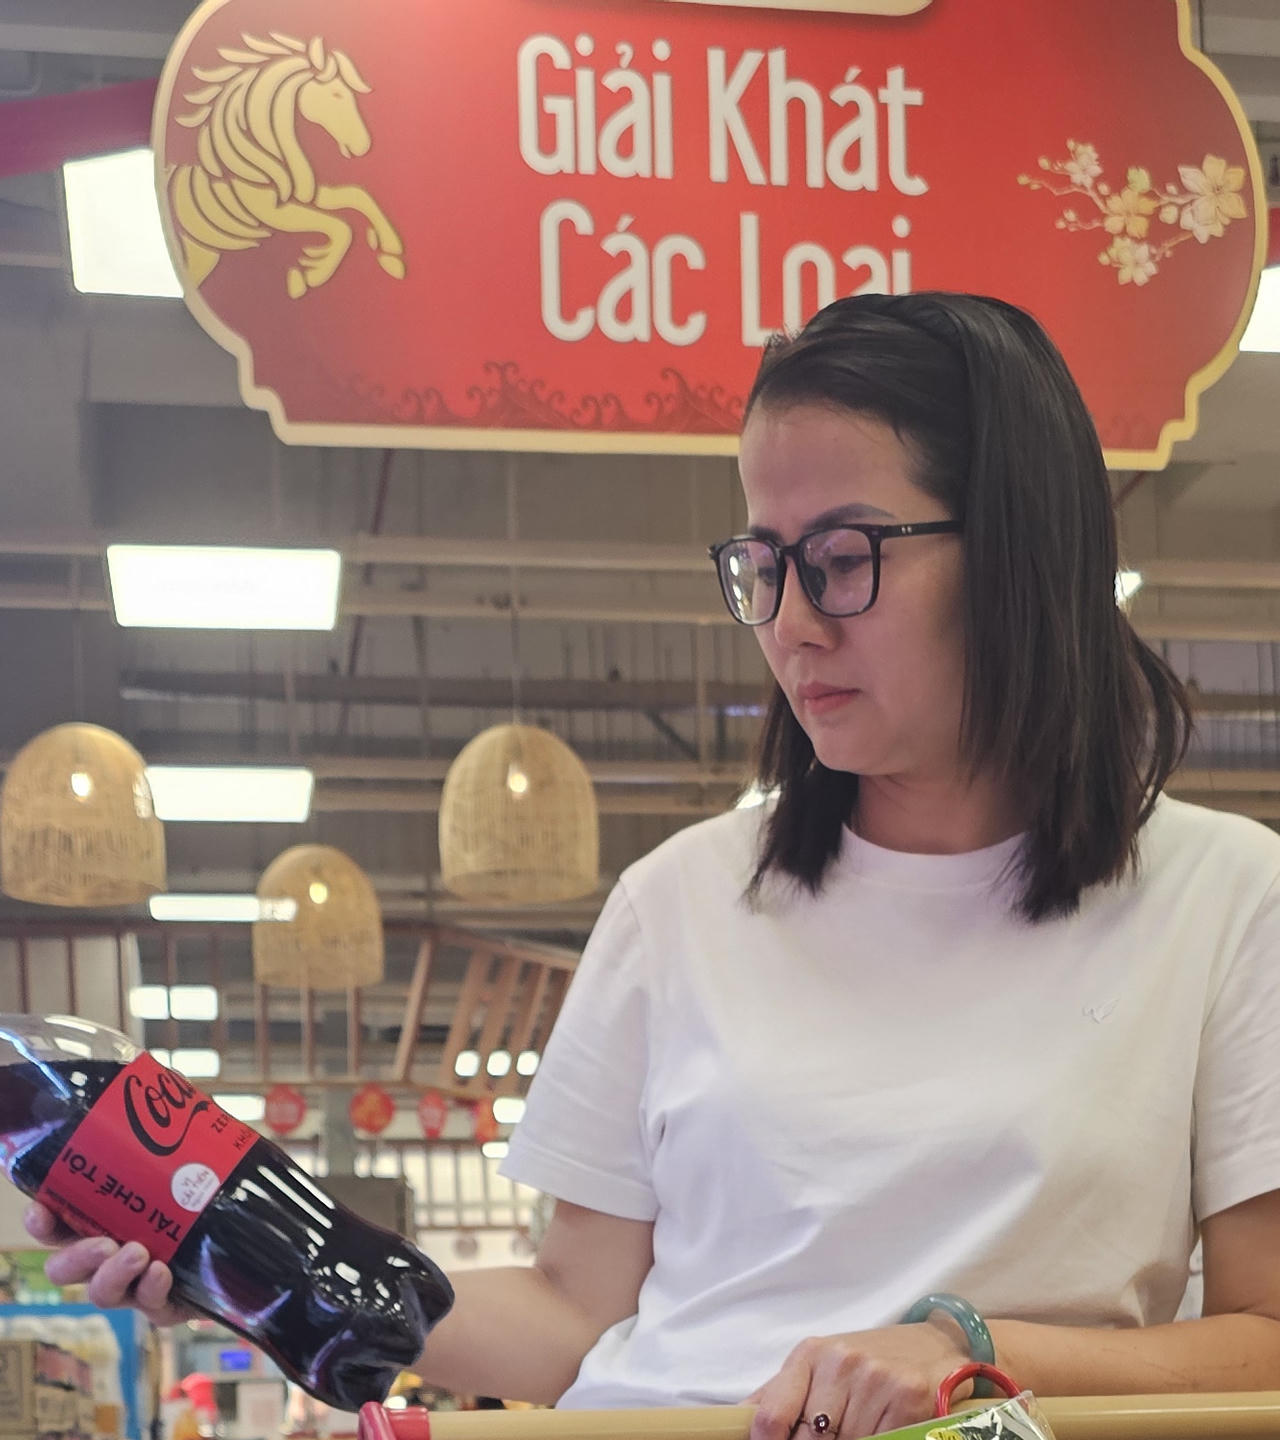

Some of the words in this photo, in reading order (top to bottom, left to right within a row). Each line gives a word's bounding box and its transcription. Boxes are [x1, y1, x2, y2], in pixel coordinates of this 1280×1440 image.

[518, 35, 673, 178] Giải
[708, 47, 927, 195] Khát
[539, 200, 706, 345] Các
[61, 1147, 97, 1183] TÔI
[95, 1174, 146, 1213] CHẾ
[148, 1208, 183, 1242] TÁI
